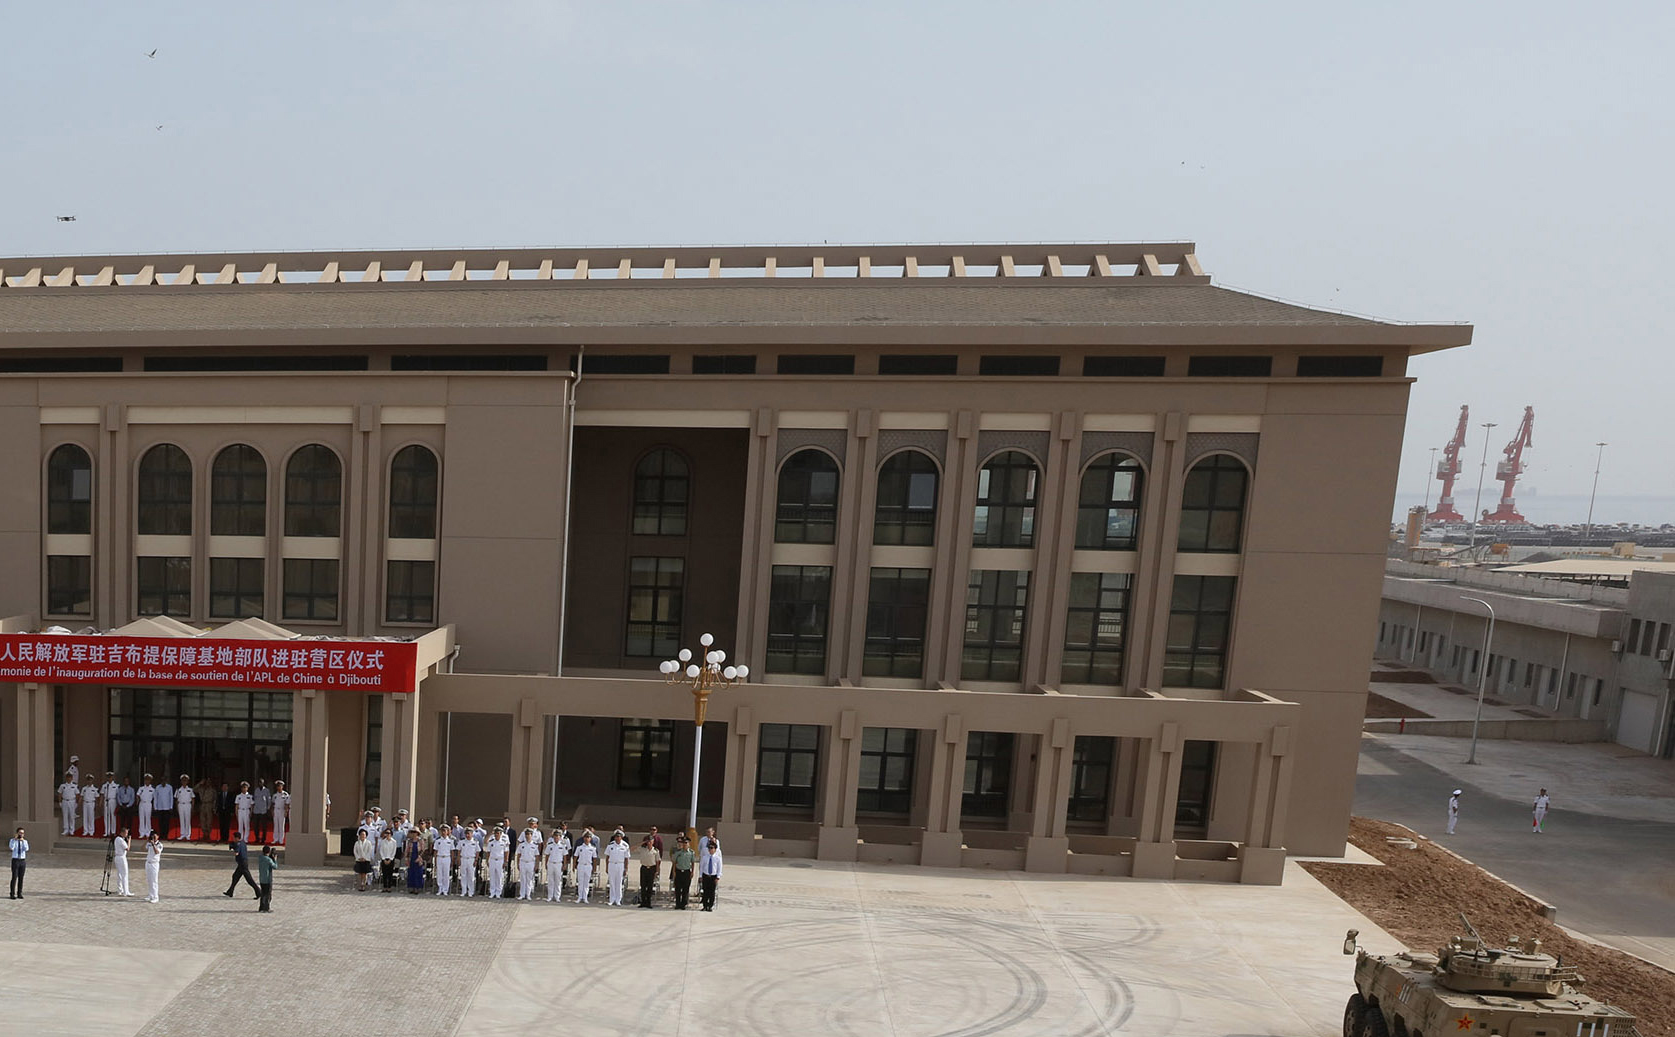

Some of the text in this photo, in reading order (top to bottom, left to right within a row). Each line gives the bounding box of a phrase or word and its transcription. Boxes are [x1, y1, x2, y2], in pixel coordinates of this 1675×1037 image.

[34, 666, 46, 678] de
[122, 667, 135, 679] de
[137, 668, 146, 680] la
[149, 668, 173, 680] base
[175, 670, 189, 680] de
[190, 670, 229, 682] soutien
[231, 671, 244, 683] de
[277, 672, 290, 684] de
[292, 672, 323, 685] Chine
[327, 673, 335, 685] à
[339, 673, 381, 687] Djibouti
